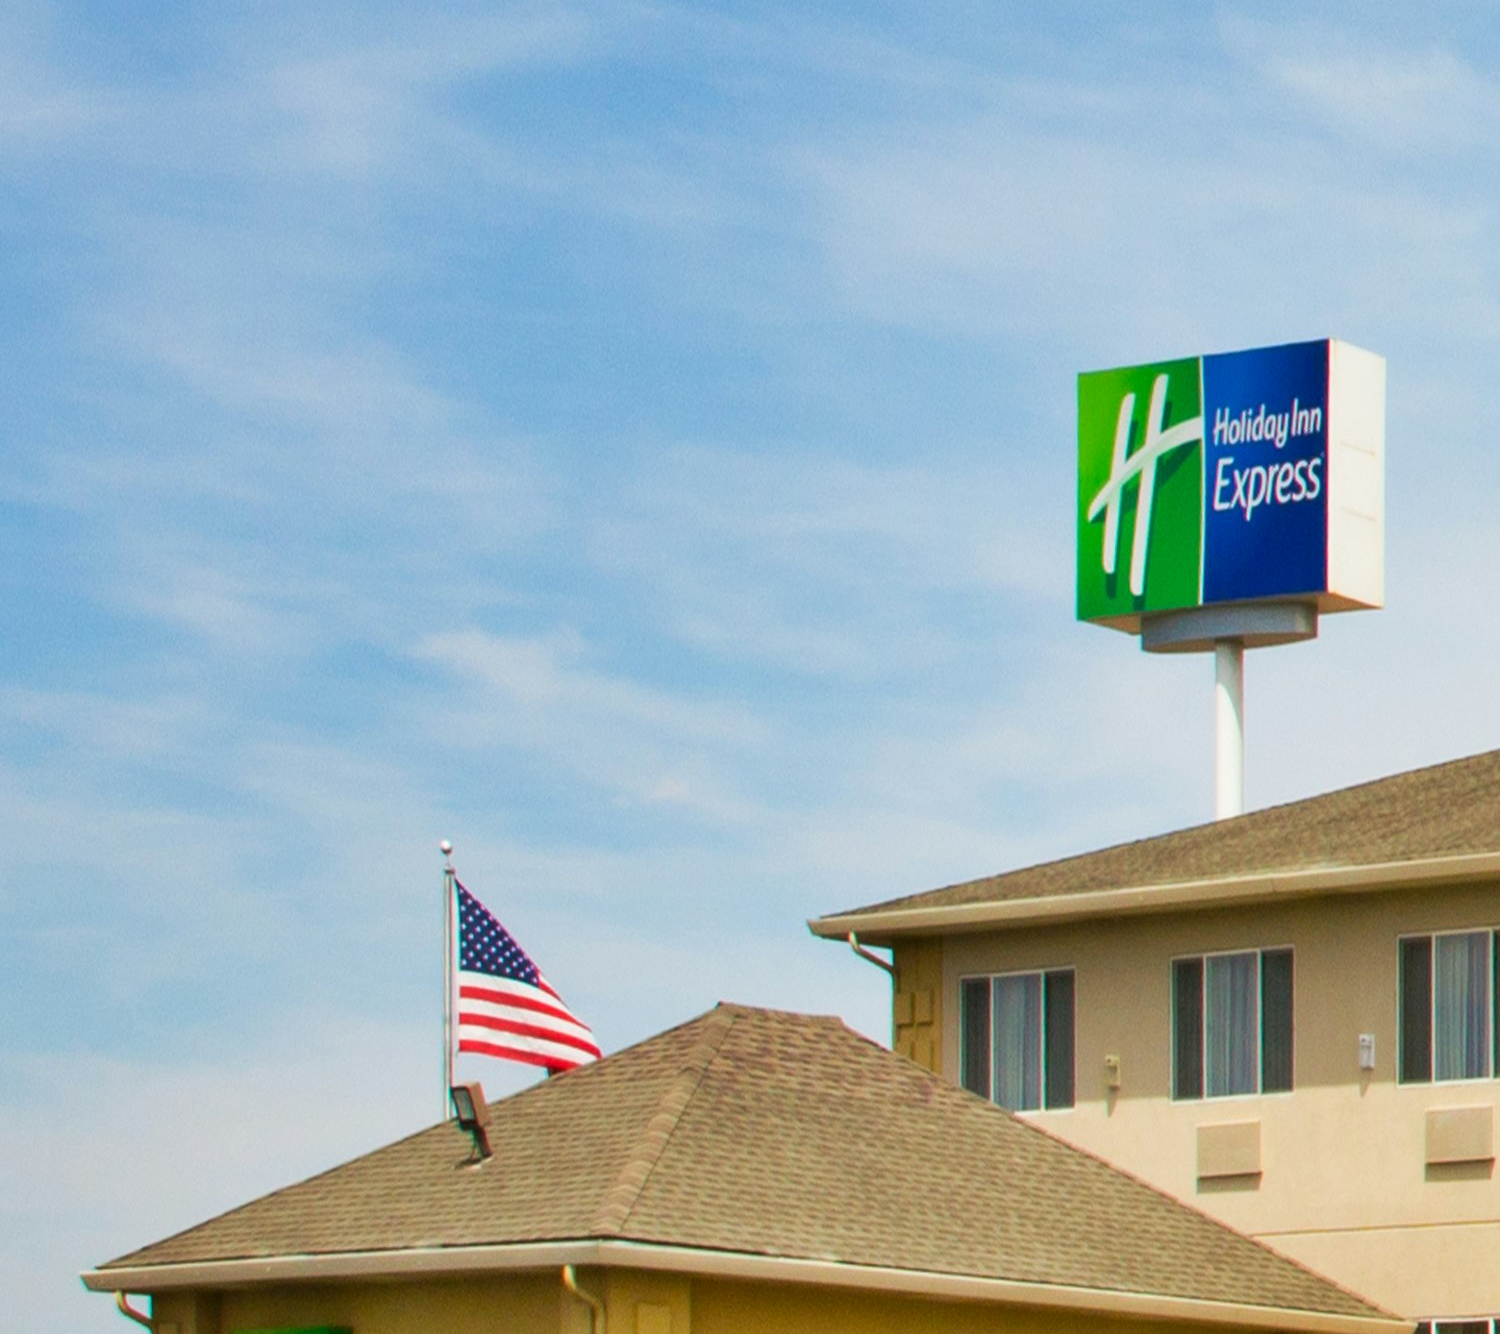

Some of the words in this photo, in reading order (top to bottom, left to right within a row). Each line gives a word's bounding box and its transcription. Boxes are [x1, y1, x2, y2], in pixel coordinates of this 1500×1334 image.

[1213, 404, 1289, 448] Holiday
[1290, 397, 1322, 437] Inn
[1213, 456, 1321, 521] Express
